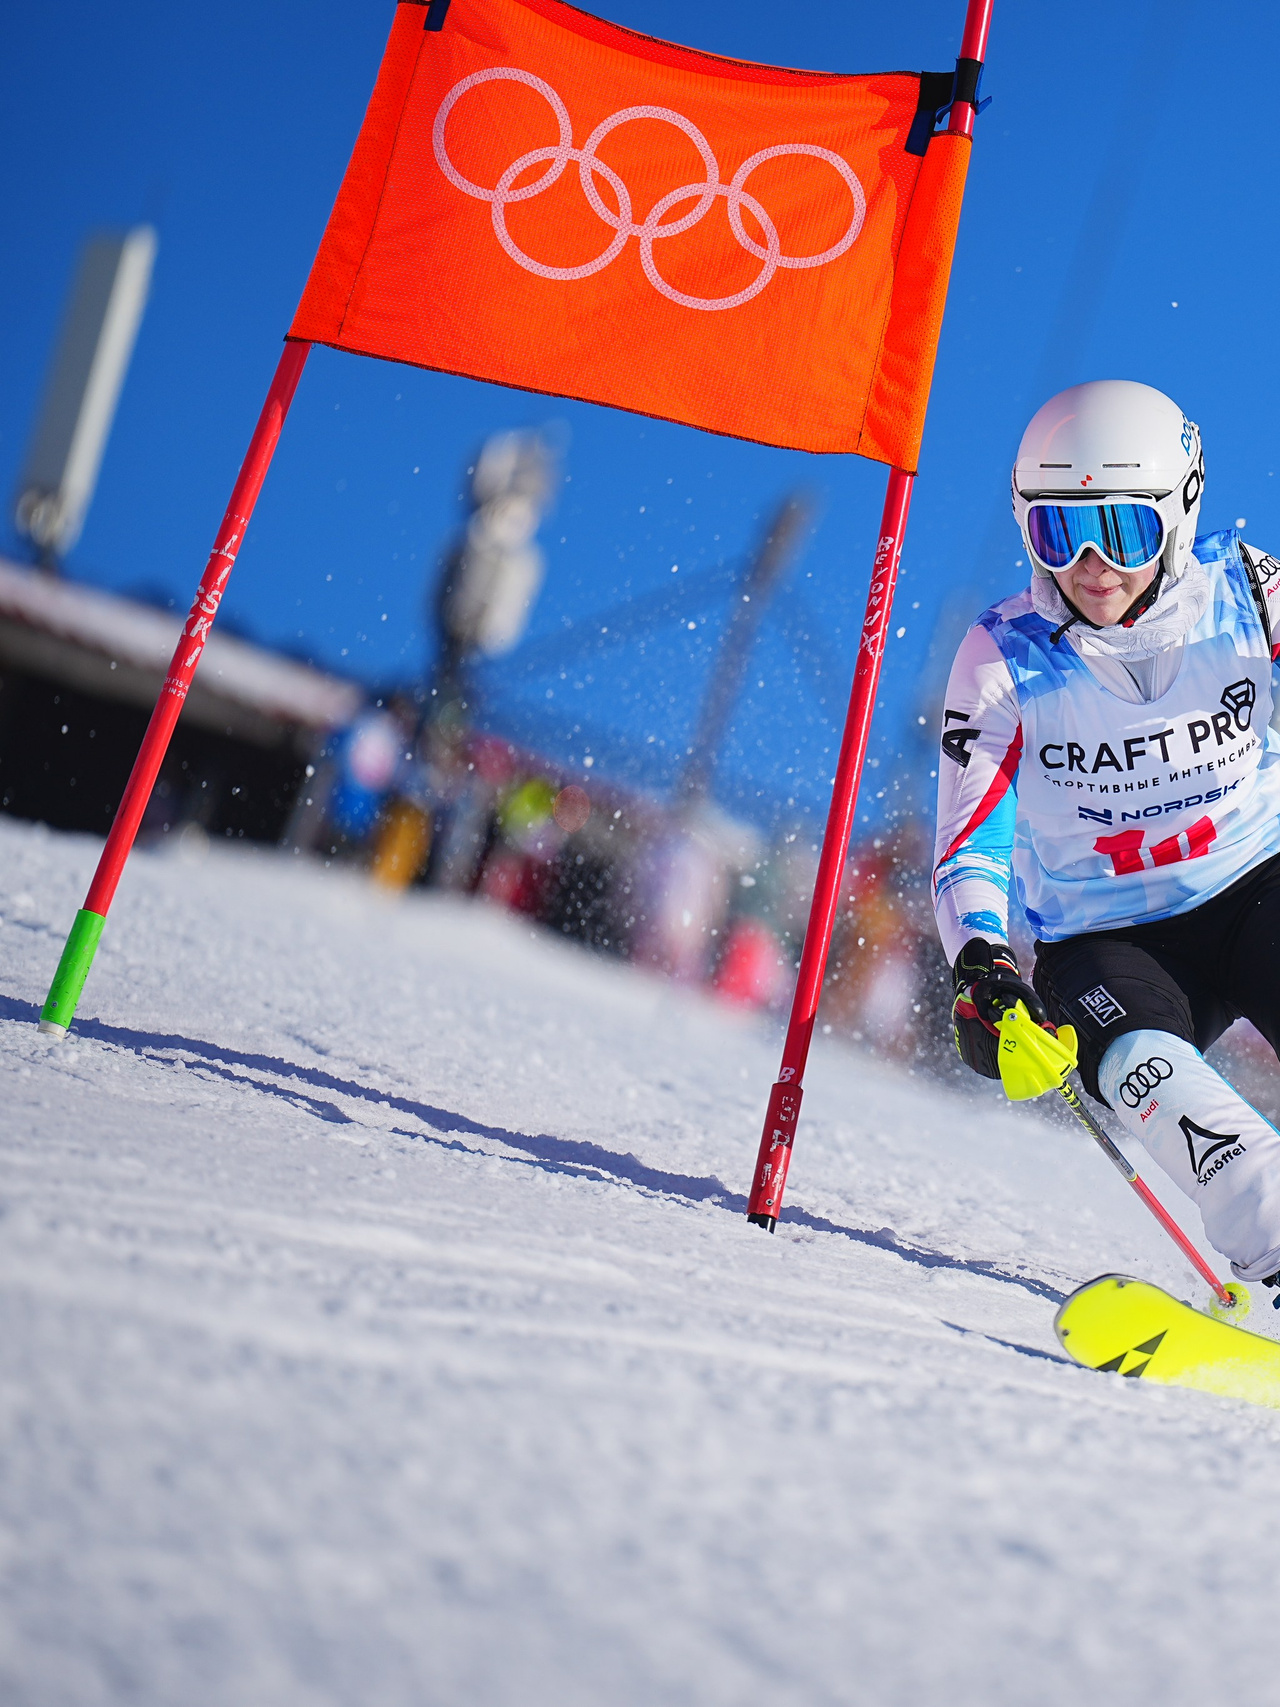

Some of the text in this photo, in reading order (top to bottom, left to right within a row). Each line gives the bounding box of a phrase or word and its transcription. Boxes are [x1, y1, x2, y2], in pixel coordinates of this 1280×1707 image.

[941, 709, 982, 769] A1
[1039, 704, 1252, 774] CRAFT PRO
[1043, 735, 1257, 794] СПОРТИВНЫЕ ИНТЕНСИВЫ
[1120, 776, 1246, 823] NORDSK
[1003, 1038, 1017, 1053] 13
[1139, 1098, 1160, 1123] Audi
[1198, 1143, 1247, 1187] Schöffel
